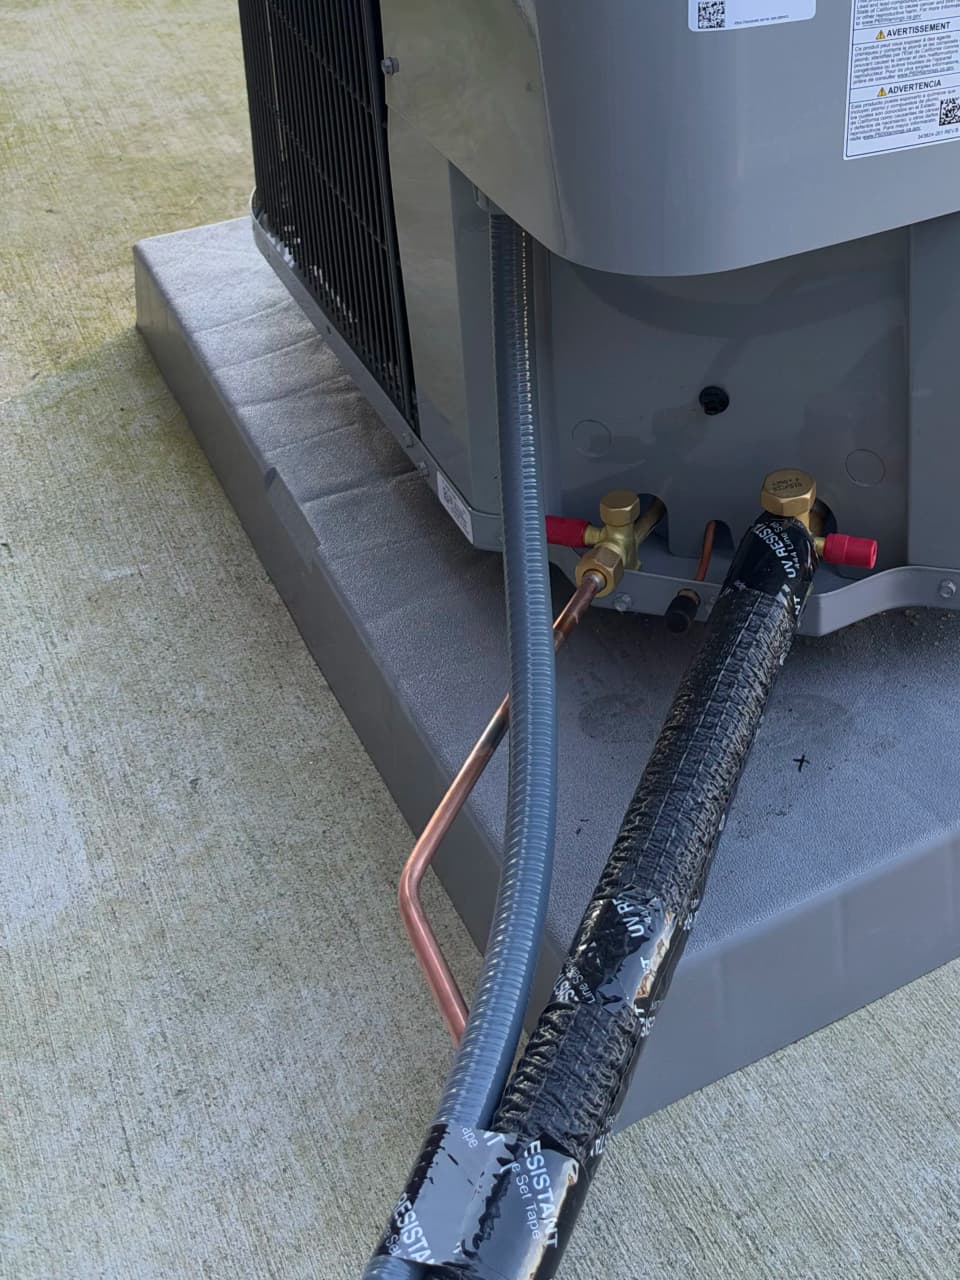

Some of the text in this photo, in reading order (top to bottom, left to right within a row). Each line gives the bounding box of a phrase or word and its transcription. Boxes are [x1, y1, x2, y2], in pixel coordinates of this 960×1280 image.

[886, 21, 951, 38] AVERTISSEMENT
[888, 79, 942, 95] ADVERTENCIA
[622, 915, 646, 938] UV
[462, 1126, 479, 1149] ape
[523, 1140, 559, 1249] ESISTANT
[515, 1173, 542, 1241] Set Tape
